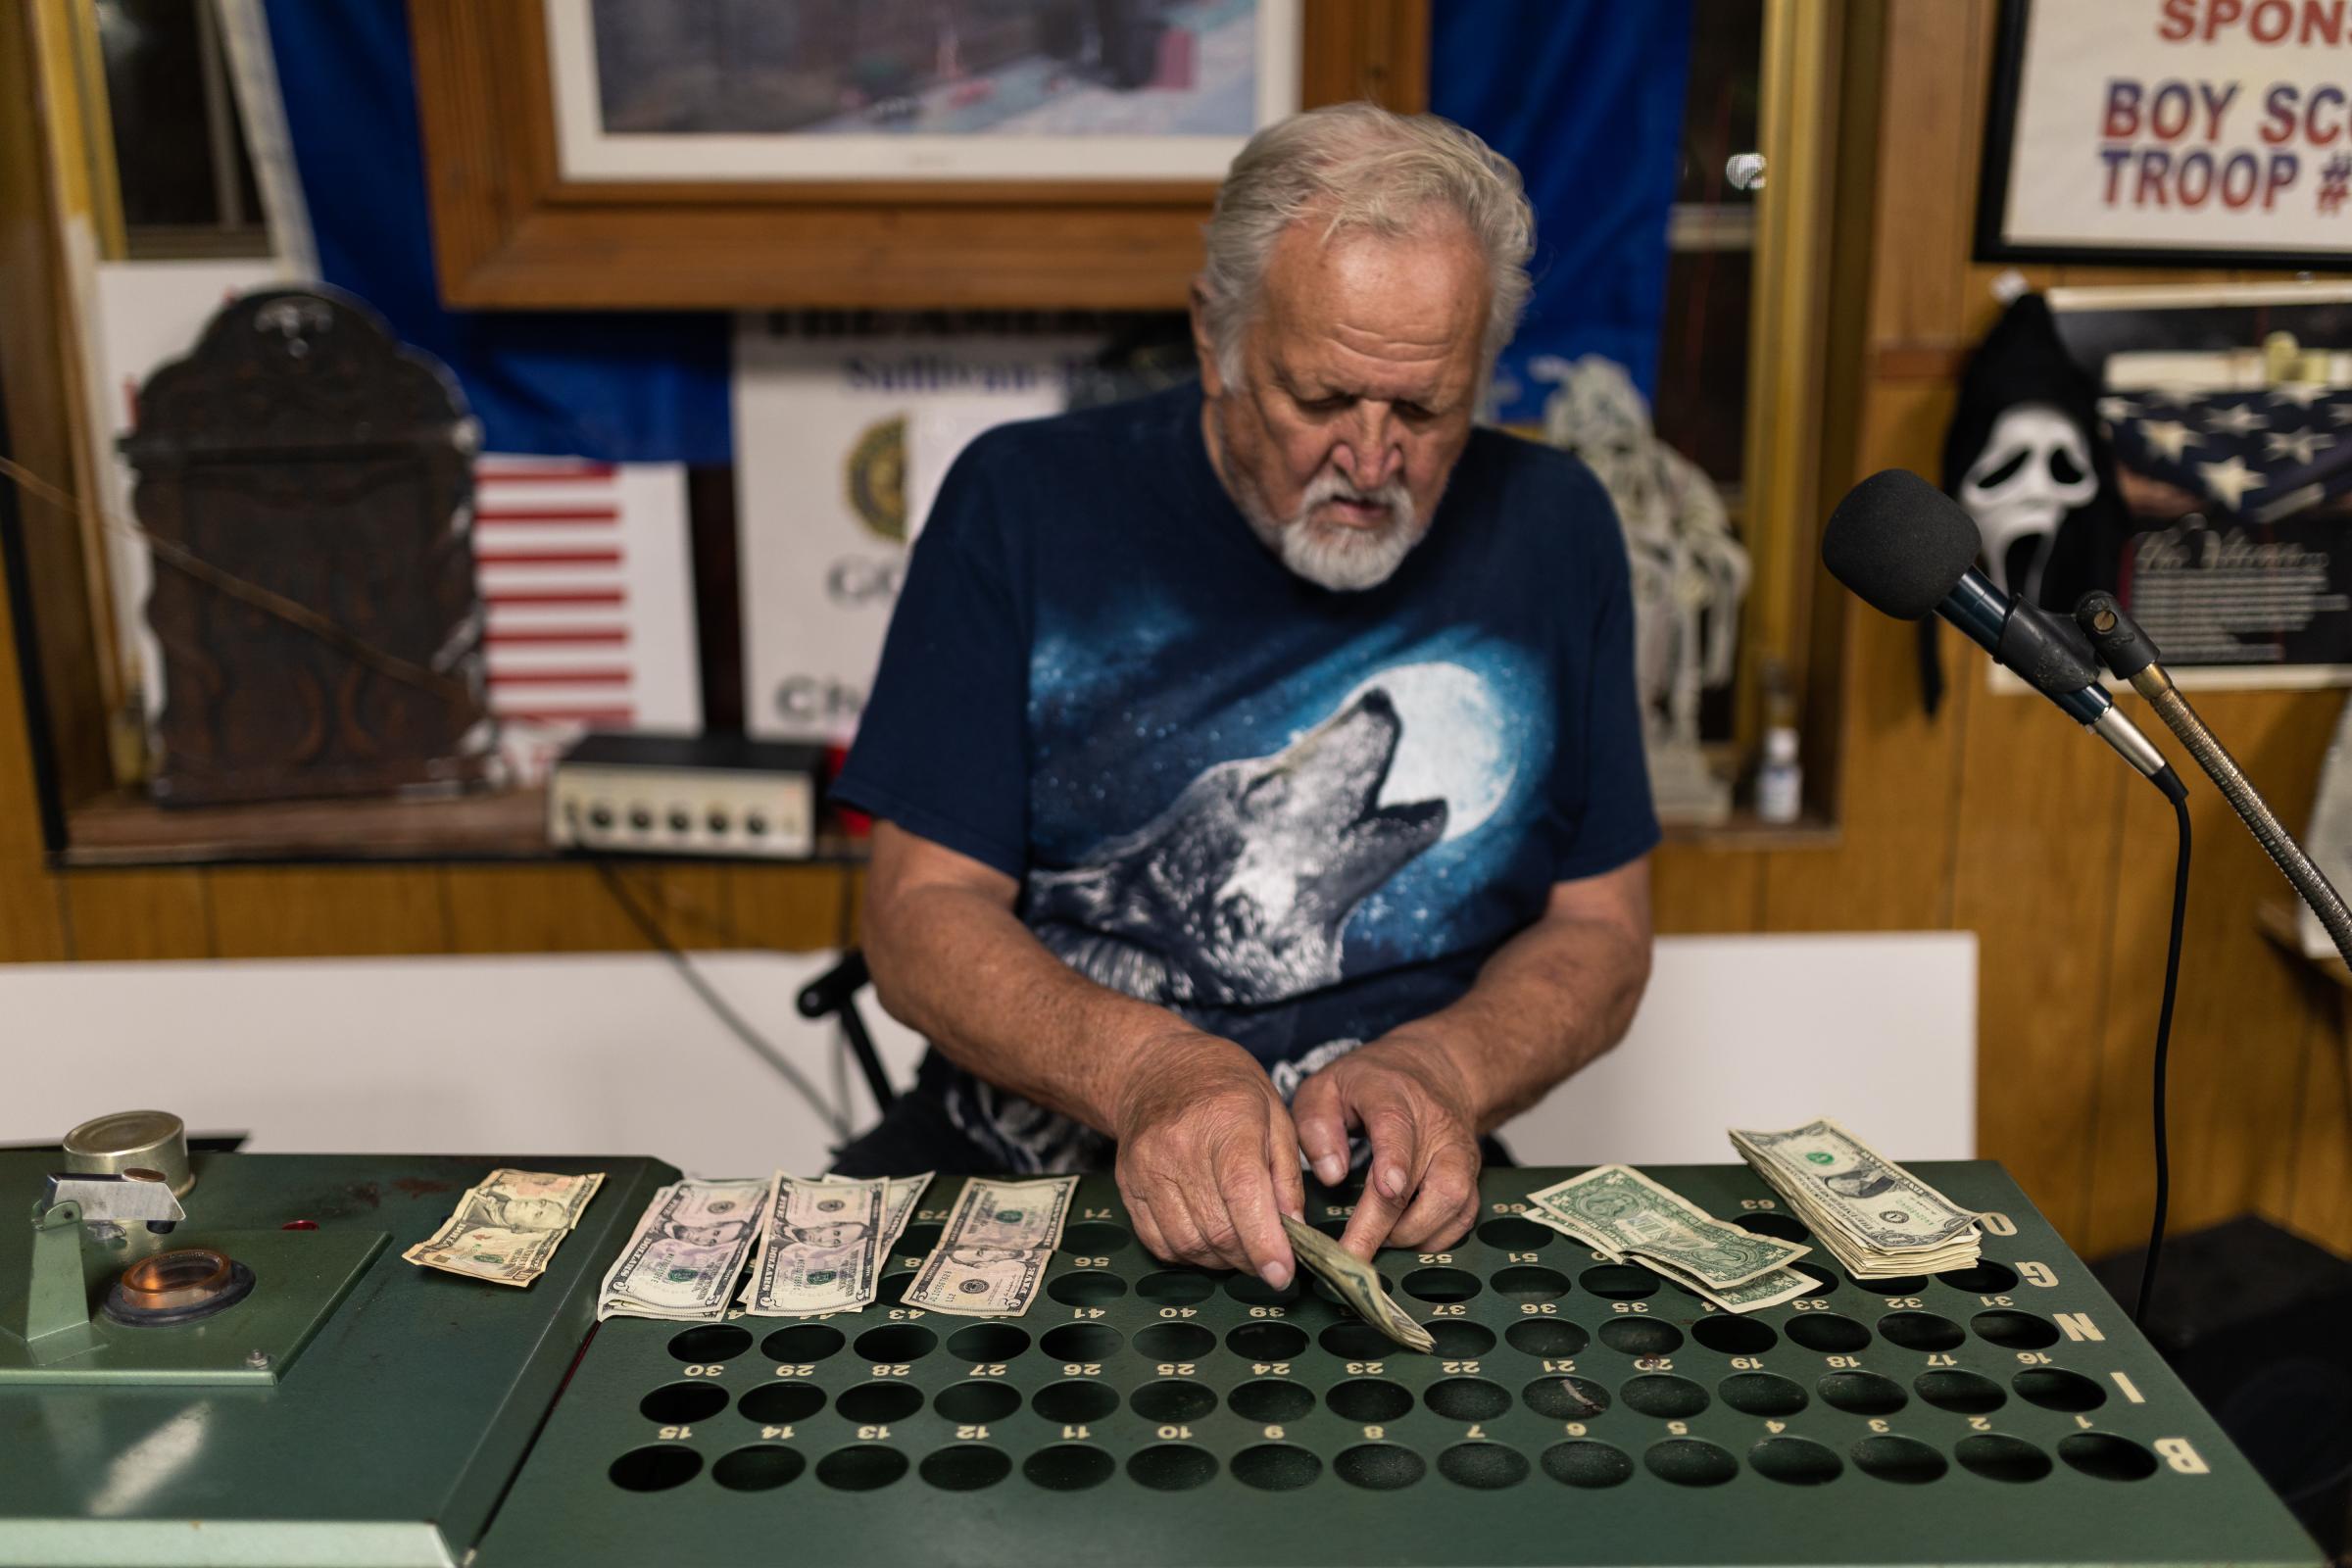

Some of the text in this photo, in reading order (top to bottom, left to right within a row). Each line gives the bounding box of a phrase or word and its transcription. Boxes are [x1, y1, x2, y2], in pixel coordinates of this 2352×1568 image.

[2159, 0, 2352, 45] SPON
[2101, 78, 2352, 145] BOY SC
[2100, 146, 2299, 210] TROOP
[1740, 1199, 1776, 1210] 63
[1084, 1208, 1112, 1219] 71
[1073, 1256, 1110, 1267] 56
[1418, 1252, 1453, 1264] 52
[1509, 1252, 1539, 1263] 51
[2015, 1260, 2059, 1289] G
[1520, 1302, 1558, 1314] 36
[1612, 1301, 1649, 1313] 35
[1791, 1298, 1830, 1311] 33
[1886, 1297, 1924, 1309] 32
[1980, 1295, 2015, 1308] 31
[888, 1308, 927, 1320] 43
[1073, 1308, 1106, 1319] 41
[1158, 1307, 1198, 1319] 40
[1249, 1306, 1286, 1318] 39
[1432, 1304, 1467, 1316] 37
[2052, 1312, 2106, 1343] N
[1730, 1356, 1764, 1370] 19
[1825, 1354, 1862, 1369] 18
[1927, 1353, 1958, 1367] 17
[2015, 1350, 2054, 1365] 16
[683, 1364, 725, 1378] 30
[775, 1363, 816, 1378] 29
[871, 1363, 910, 1377] 28
[968, 1363, 1007, 1377] 27
[1063, 1363, 1102, 1377] 26
[1155, 1362, 1196, 1377] 25
[1251, 1362, 1291, 1375] 24
[1346, 1361, 1384, 1375] 23
[1443, 1359, 1480, 1374] 22
[1542, 1359, 1576, 1372] 21
[2110, 1371, 2146, 1404] I
[658, 1415, 2211, 1474] B 1 2 3 4 5 6 7 8 9 10 11 12 13 14 15
